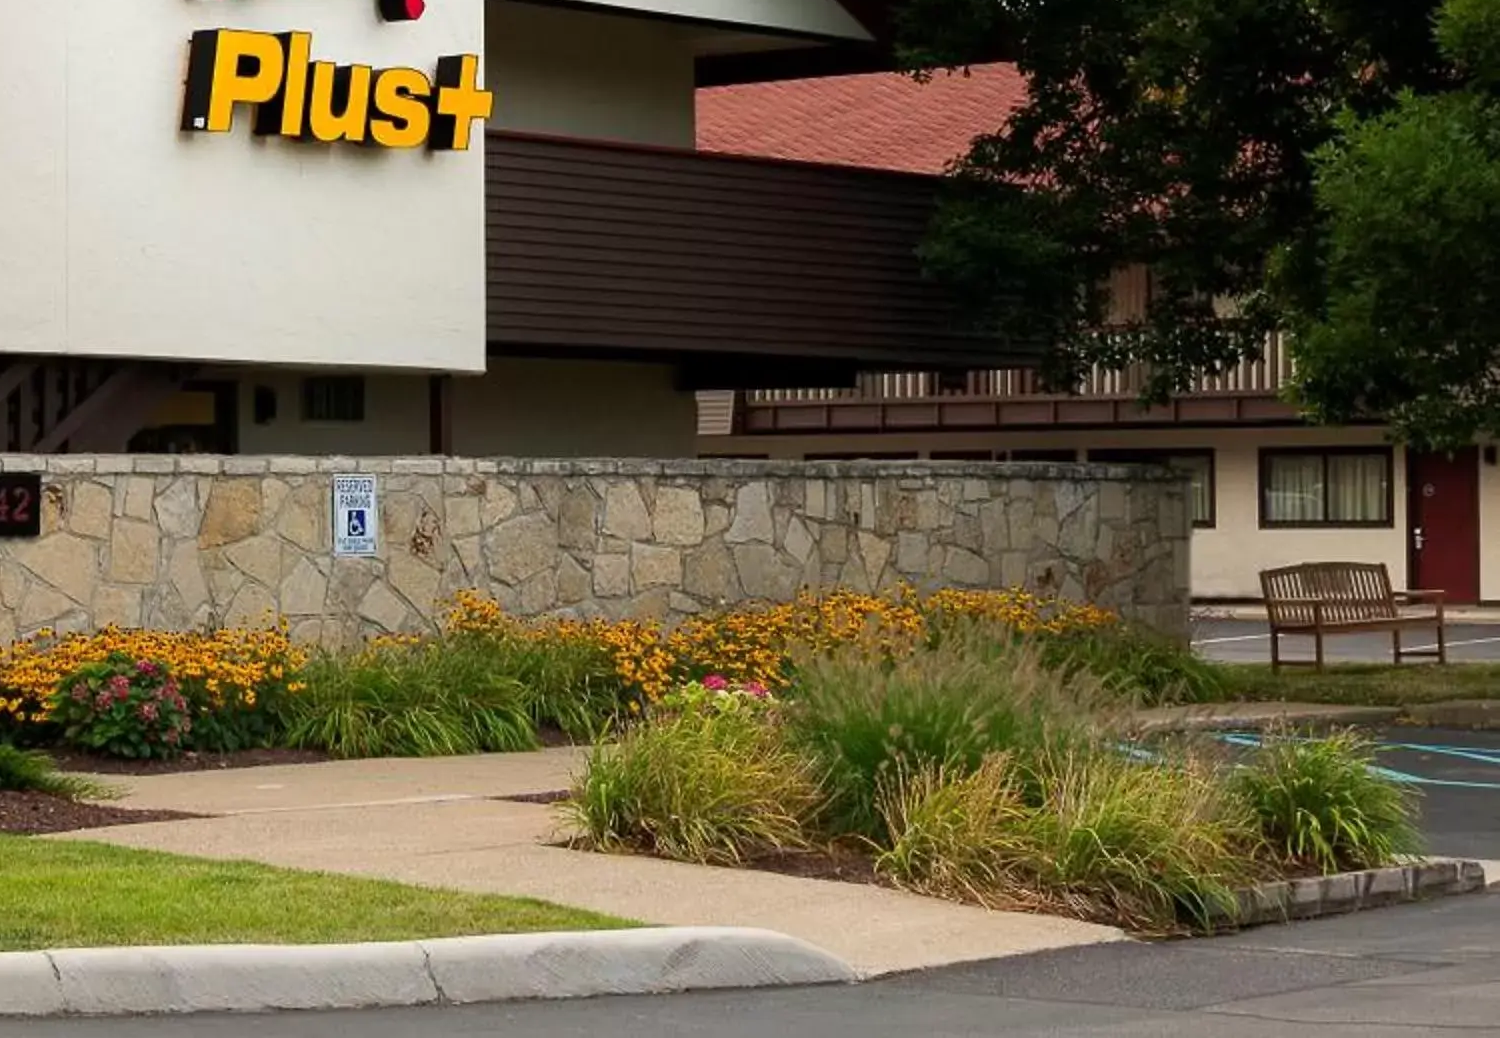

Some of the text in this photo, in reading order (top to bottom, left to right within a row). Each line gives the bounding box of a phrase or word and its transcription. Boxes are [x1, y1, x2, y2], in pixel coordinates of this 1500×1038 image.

[206, 28, 494, 151] Plus+
[336, 478, 373, 493] RESERVED
[339, 494, 371, 509] PARKING
